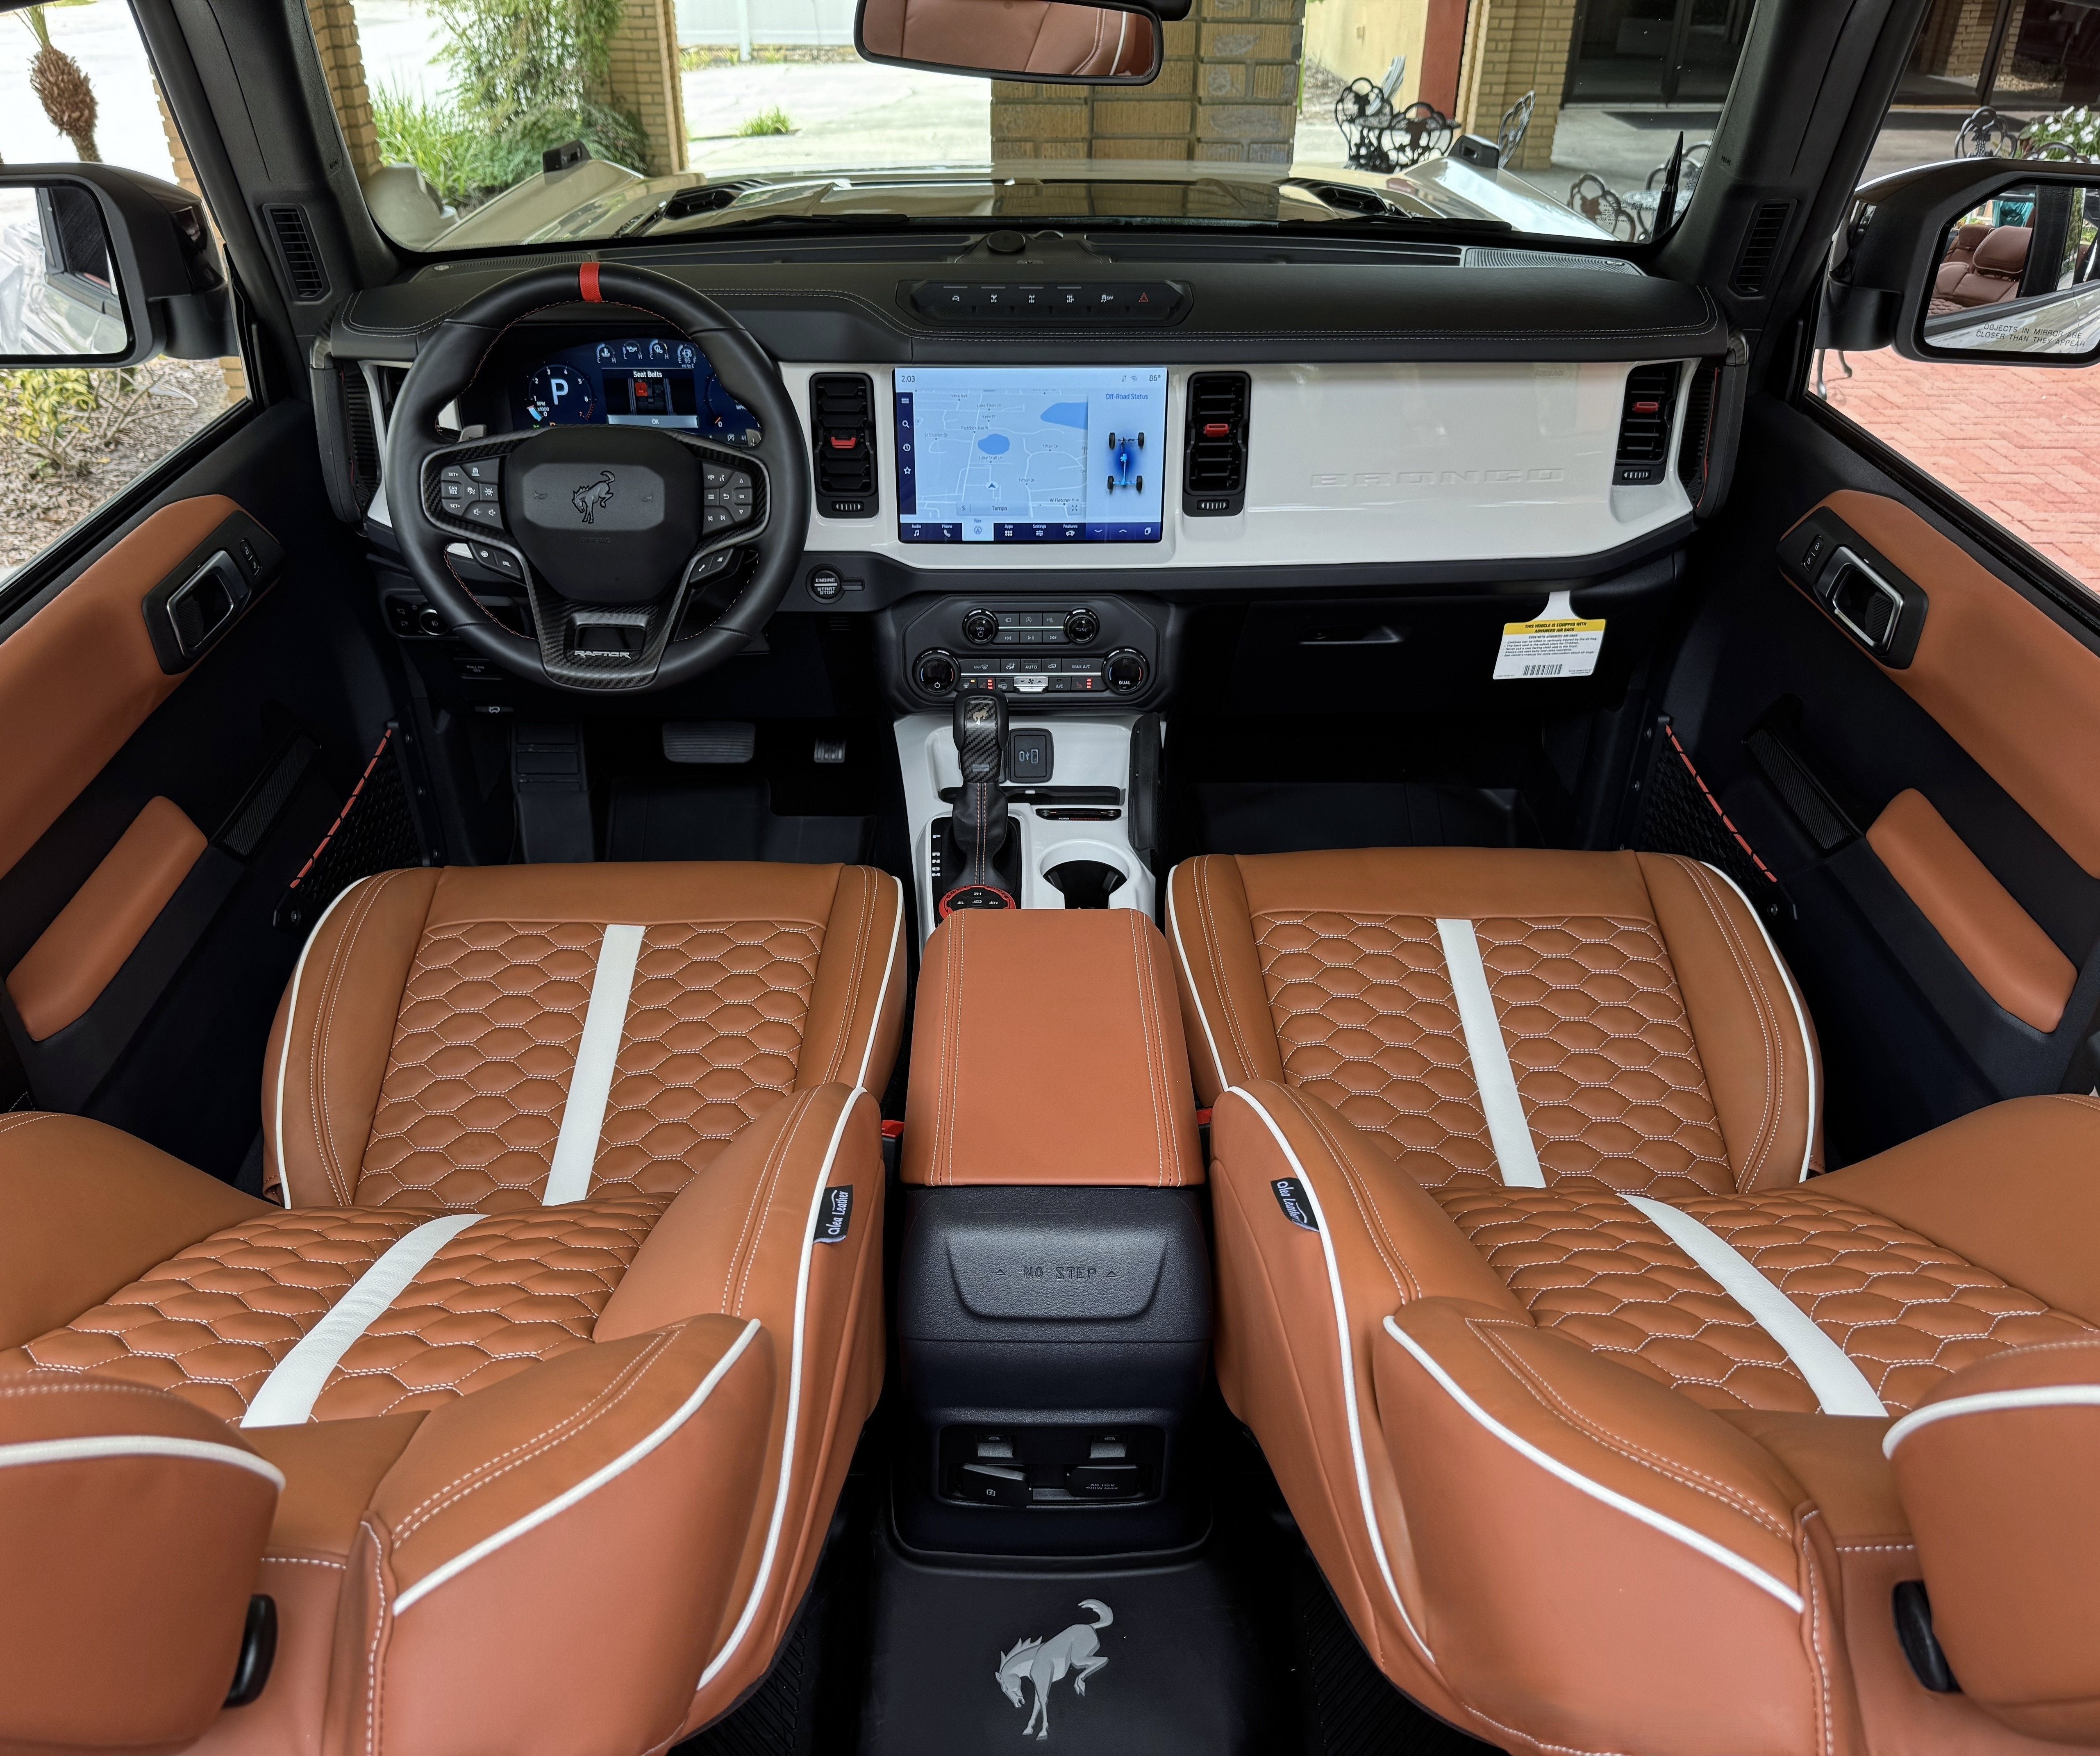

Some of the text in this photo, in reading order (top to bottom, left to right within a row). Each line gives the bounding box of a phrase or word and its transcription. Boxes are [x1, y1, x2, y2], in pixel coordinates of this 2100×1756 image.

[1984, 323, 2018, 333] OBJECTS
[2034, 328, 2063, 337] MIRROR
[1976, 331, 2005, 339] CLOSER
[2033, 336, 2052, 344] THEY
[2055, 339, 2085, 347] APPEAR
[551, 378, 568, 405] P
[1311, 468, 1564, 488] BRONCO
[575, 651, 632, 660] RAPTOR
[832, 1191, 848, 1215] Leather
[1024, 1266, 1097, 1280] NO STEP
